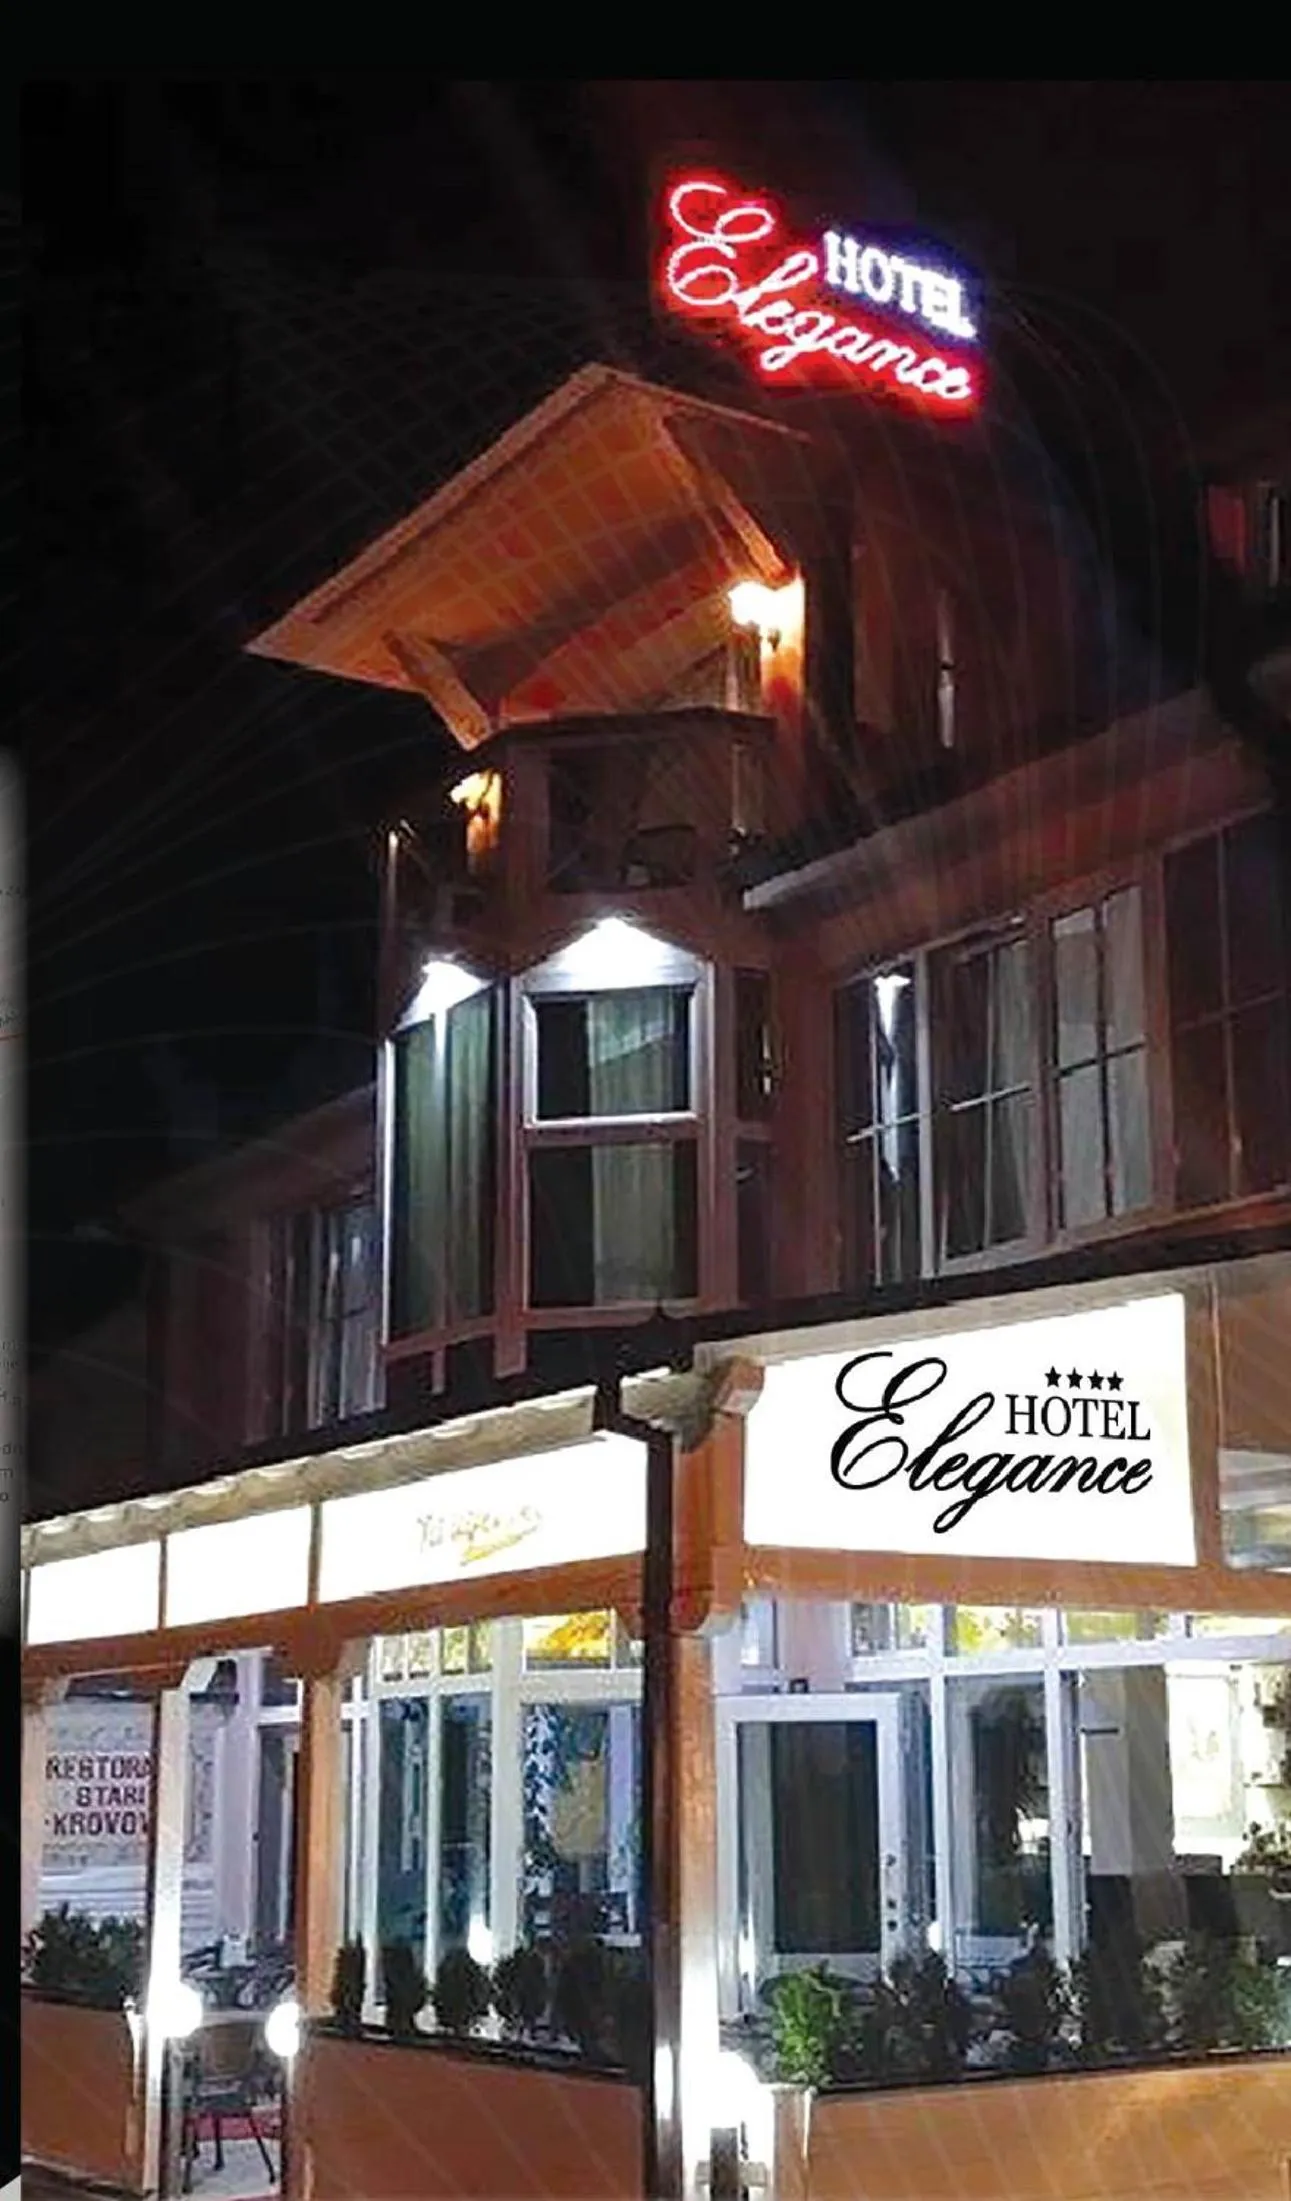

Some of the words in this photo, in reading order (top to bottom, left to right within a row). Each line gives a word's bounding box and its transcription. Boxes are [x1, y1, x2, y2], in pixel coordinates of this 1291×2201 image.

[668, 182, 973, 401] Elegance
[822, 228, 977, 340] HOTEL
[831, 1351, 1153, 1534] Elegance
[1004, 1394, 1151, 1441] HOTEL
[76, 1786, 146, 1807] STARI
